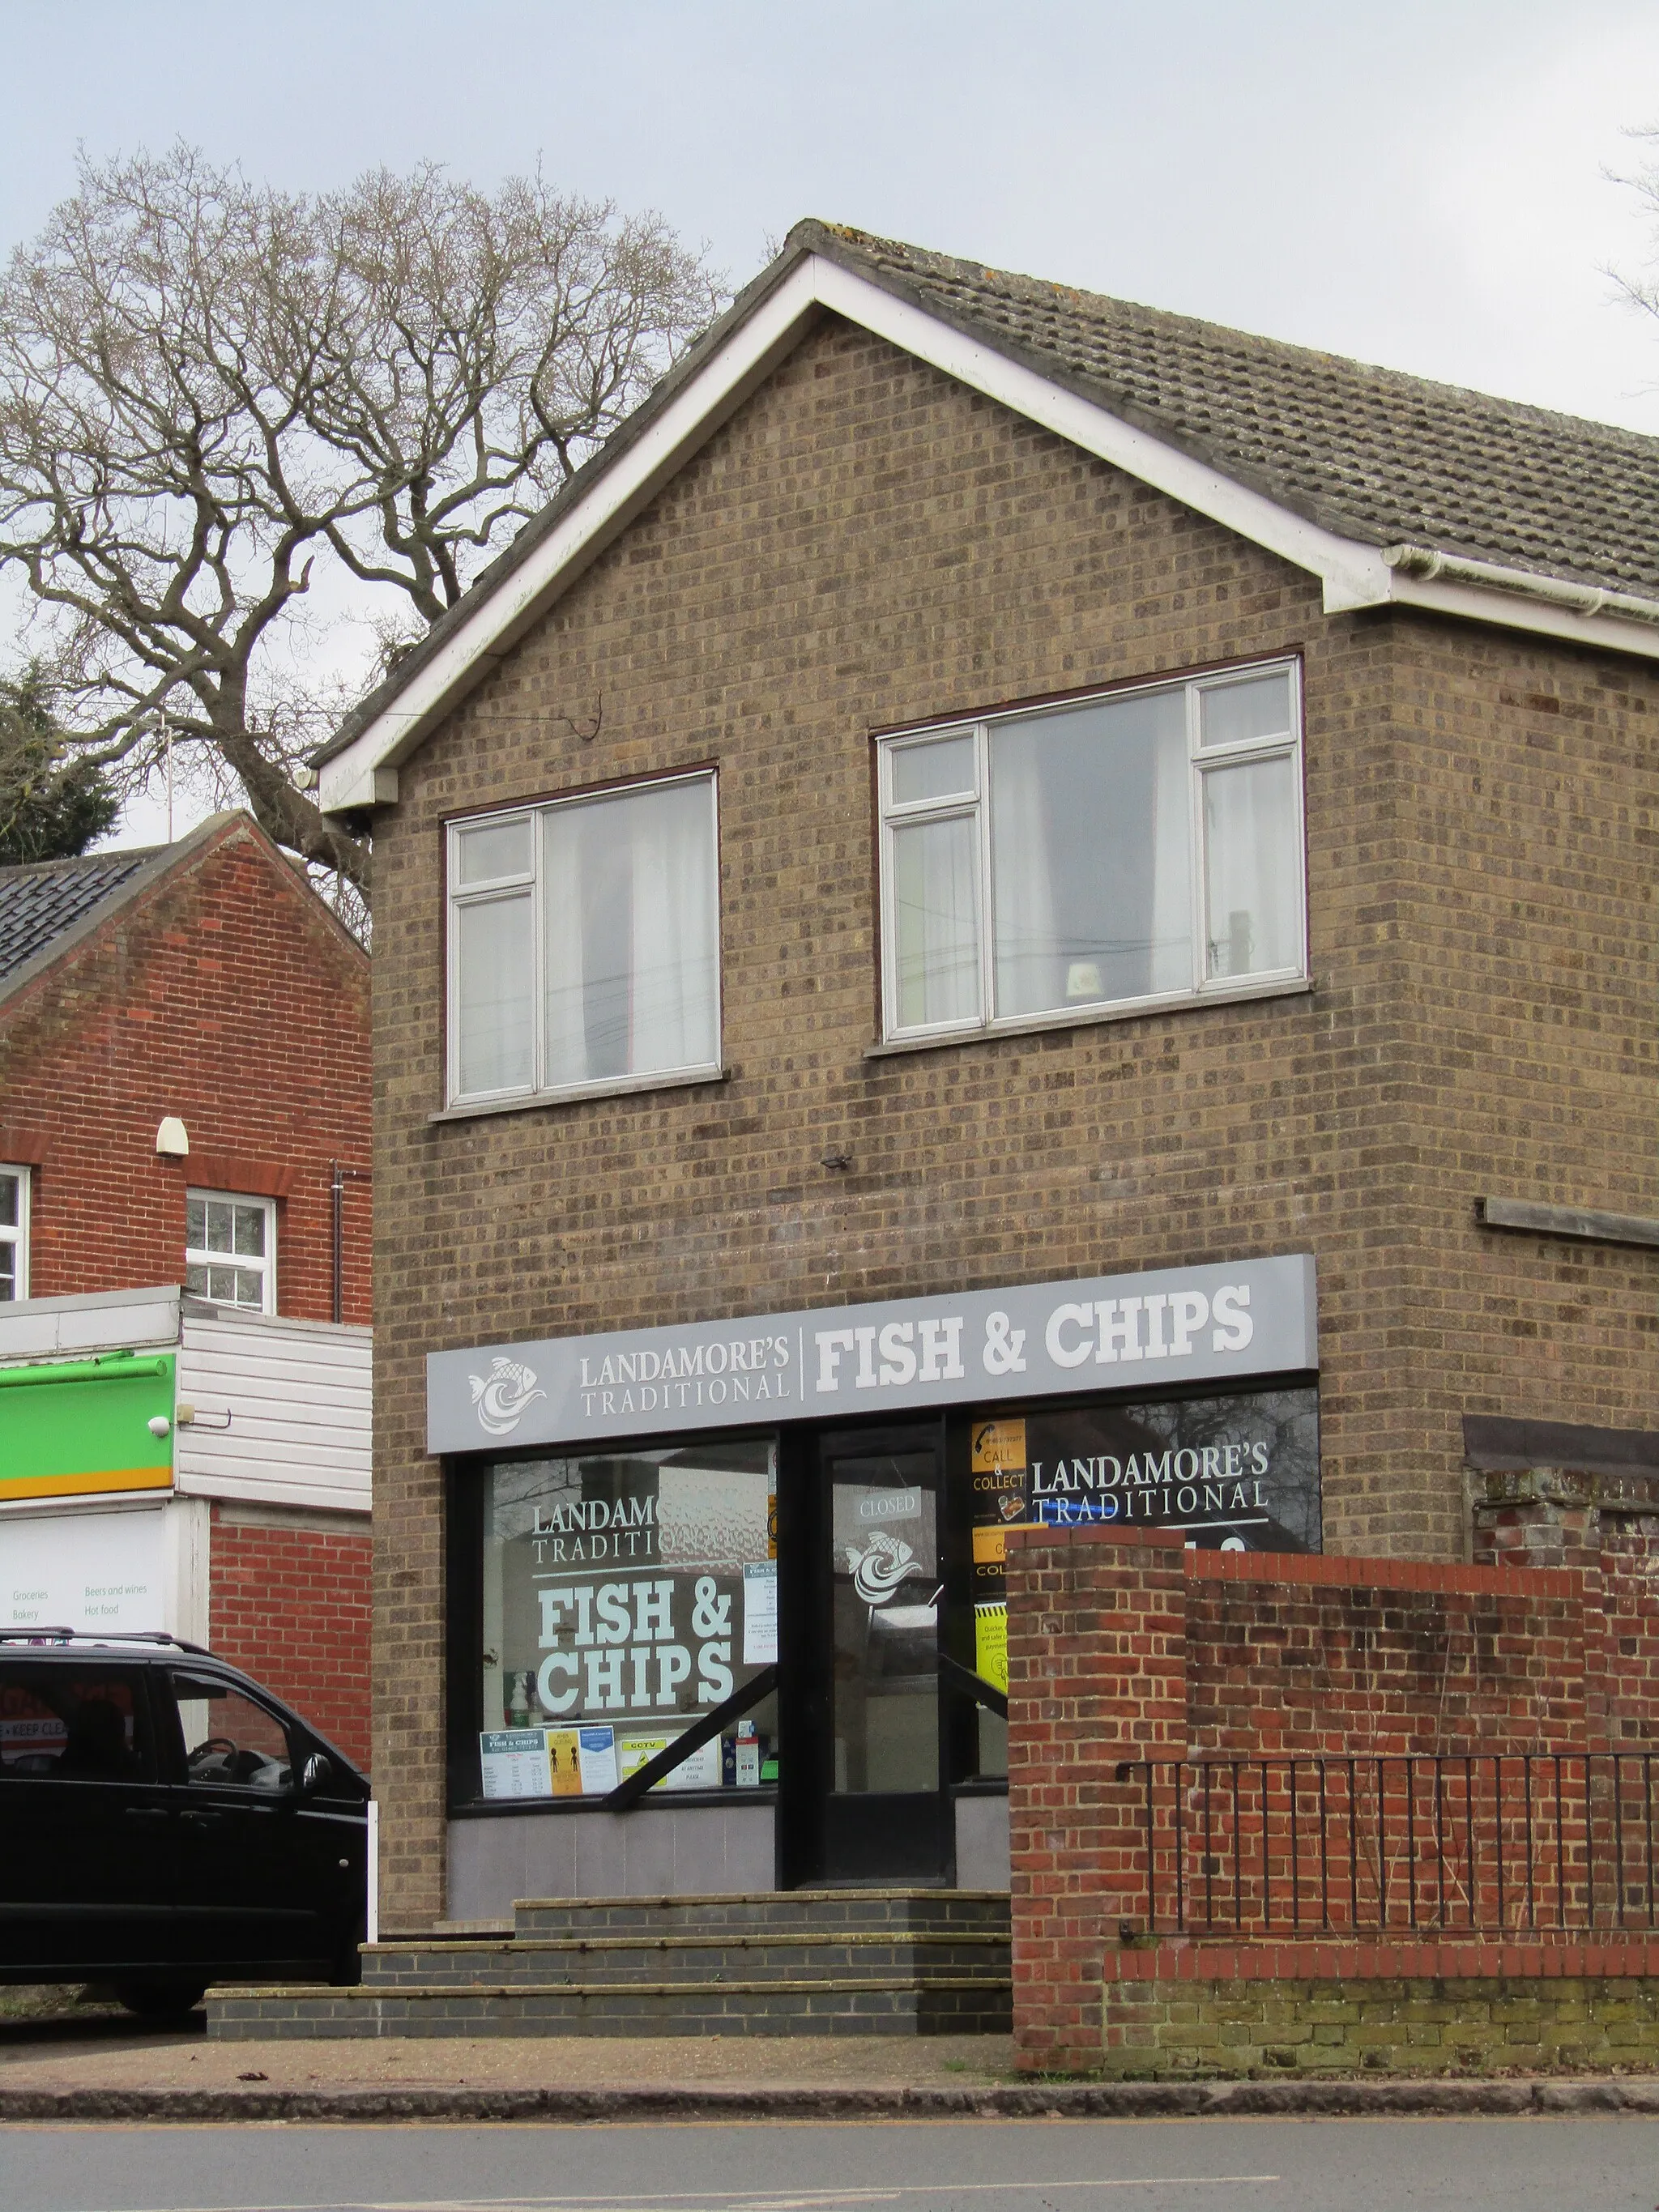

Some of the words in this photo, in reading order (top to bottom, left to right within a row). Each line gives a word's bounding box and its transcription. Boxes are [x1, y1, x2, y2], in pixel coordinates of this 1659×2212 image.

[815, 1316, 965, 1392] FISH
[983, 1311, 1026, 1375] &
[1045, 1285, 1254, 1369] CHIPS
[580, 1336, 790, 1388] LANDAMORE'S
[581, 1373, 791, 1417] TRADITIONAL
[983, 1448, 1013, 1464] CALL
[994, 1464, 1003, 1476] &
[1032, 1442, 1268, 1494] LANDAMORE'S
[974, 1474, 1025, 1490] COLLECT
[859, 1495, 915, 1518] CLOSED
[1032, 1481, 1269, 1524] TRADITIONAL
[976, 1565, 1005, 1576] COL
[13, 1590, 49, 1600] Groceries
[84, 1587, 106, 1596] Beers
[108, 1584, 123, 1595] and
[125, 1584, 147, 1595] wines
[13, 1609, 39, 1621] Bakery
[84, 1606, 99, 1615] Hot
[101, 1604, 119, 1615] food
[538, 1579, 675, 1649] FISH
[692, 1576, 731, 1638] &
[537, 1641, 734, 1712] CHIPS
